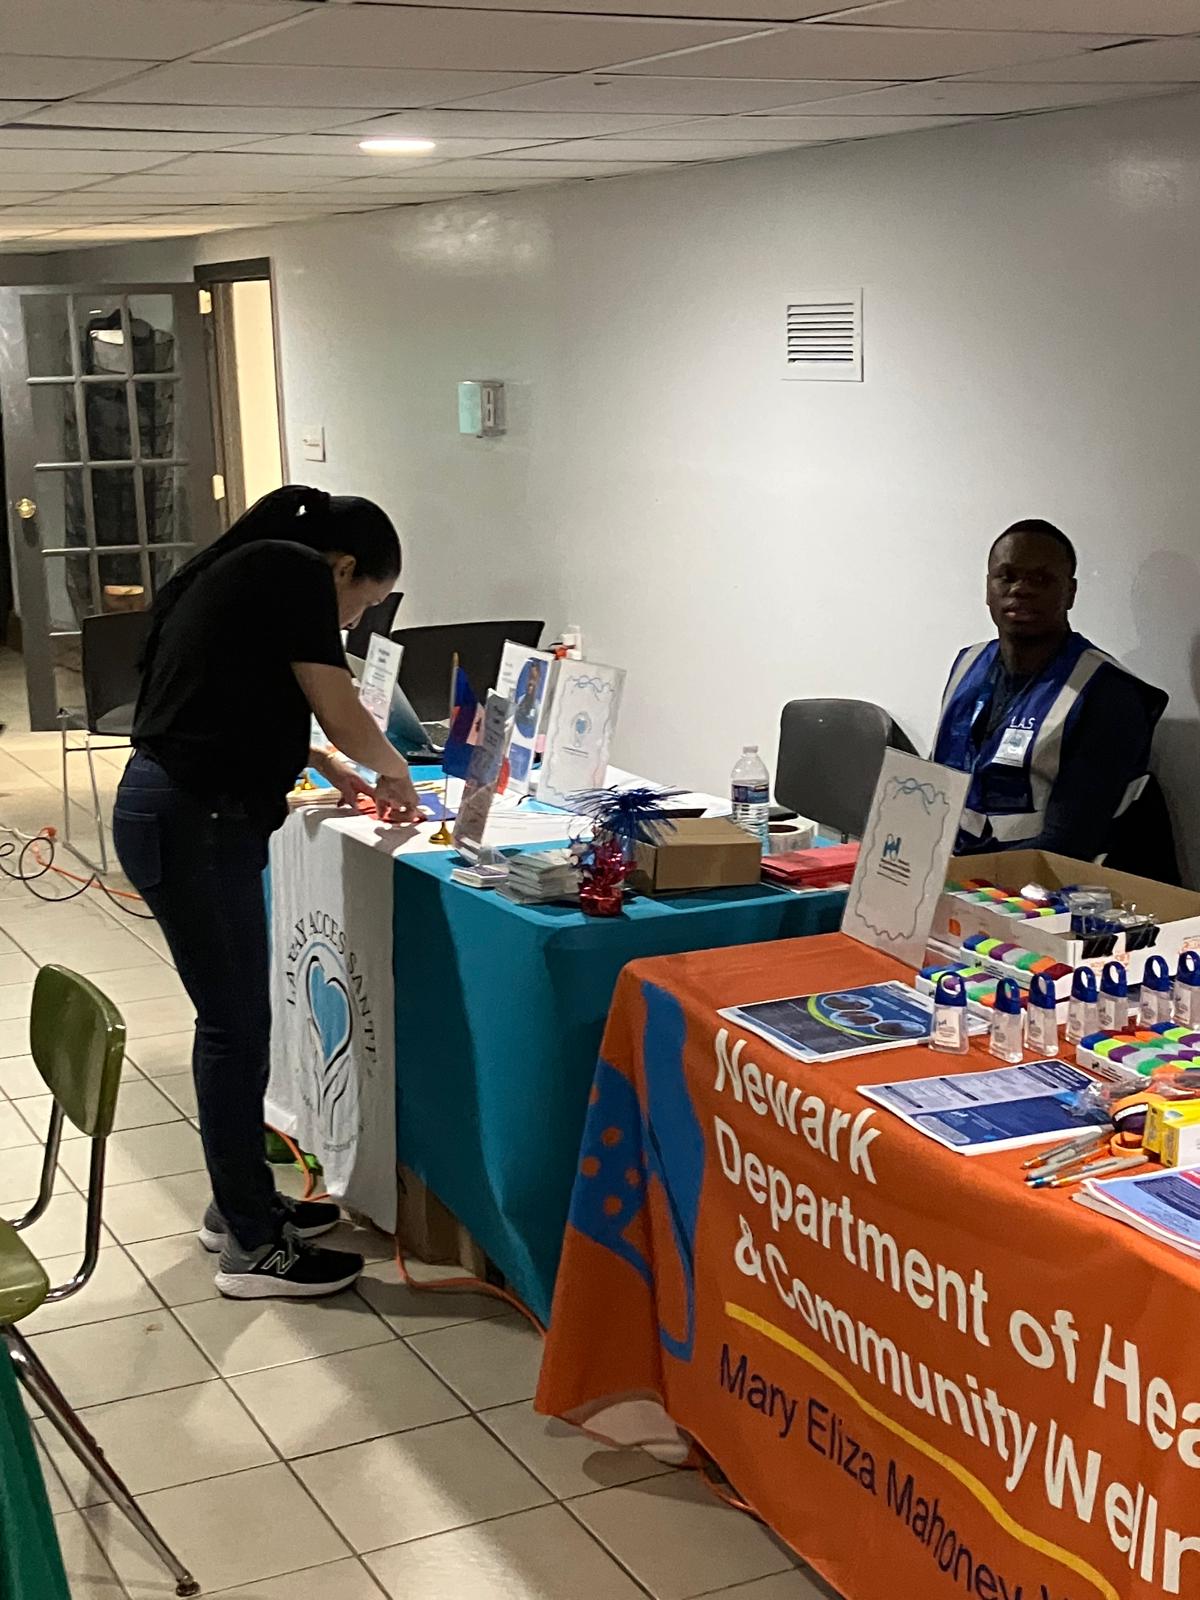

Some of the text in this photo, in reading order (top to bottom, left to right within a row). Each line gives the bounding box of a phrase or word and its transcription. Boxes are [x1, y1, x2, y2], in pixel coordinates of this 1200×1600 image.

[714, 1028, 881, 1184] Newark
[714, 1116, 990, 1347] Department
[1009, 1309, 1079, 1383] of
[734, 1214, 766, 1283] &
[765, 1249, 1038, 1492] Community
[719, 1343, 797, 1438] Mary
[807, 1397, 877, 1496] Eliza
